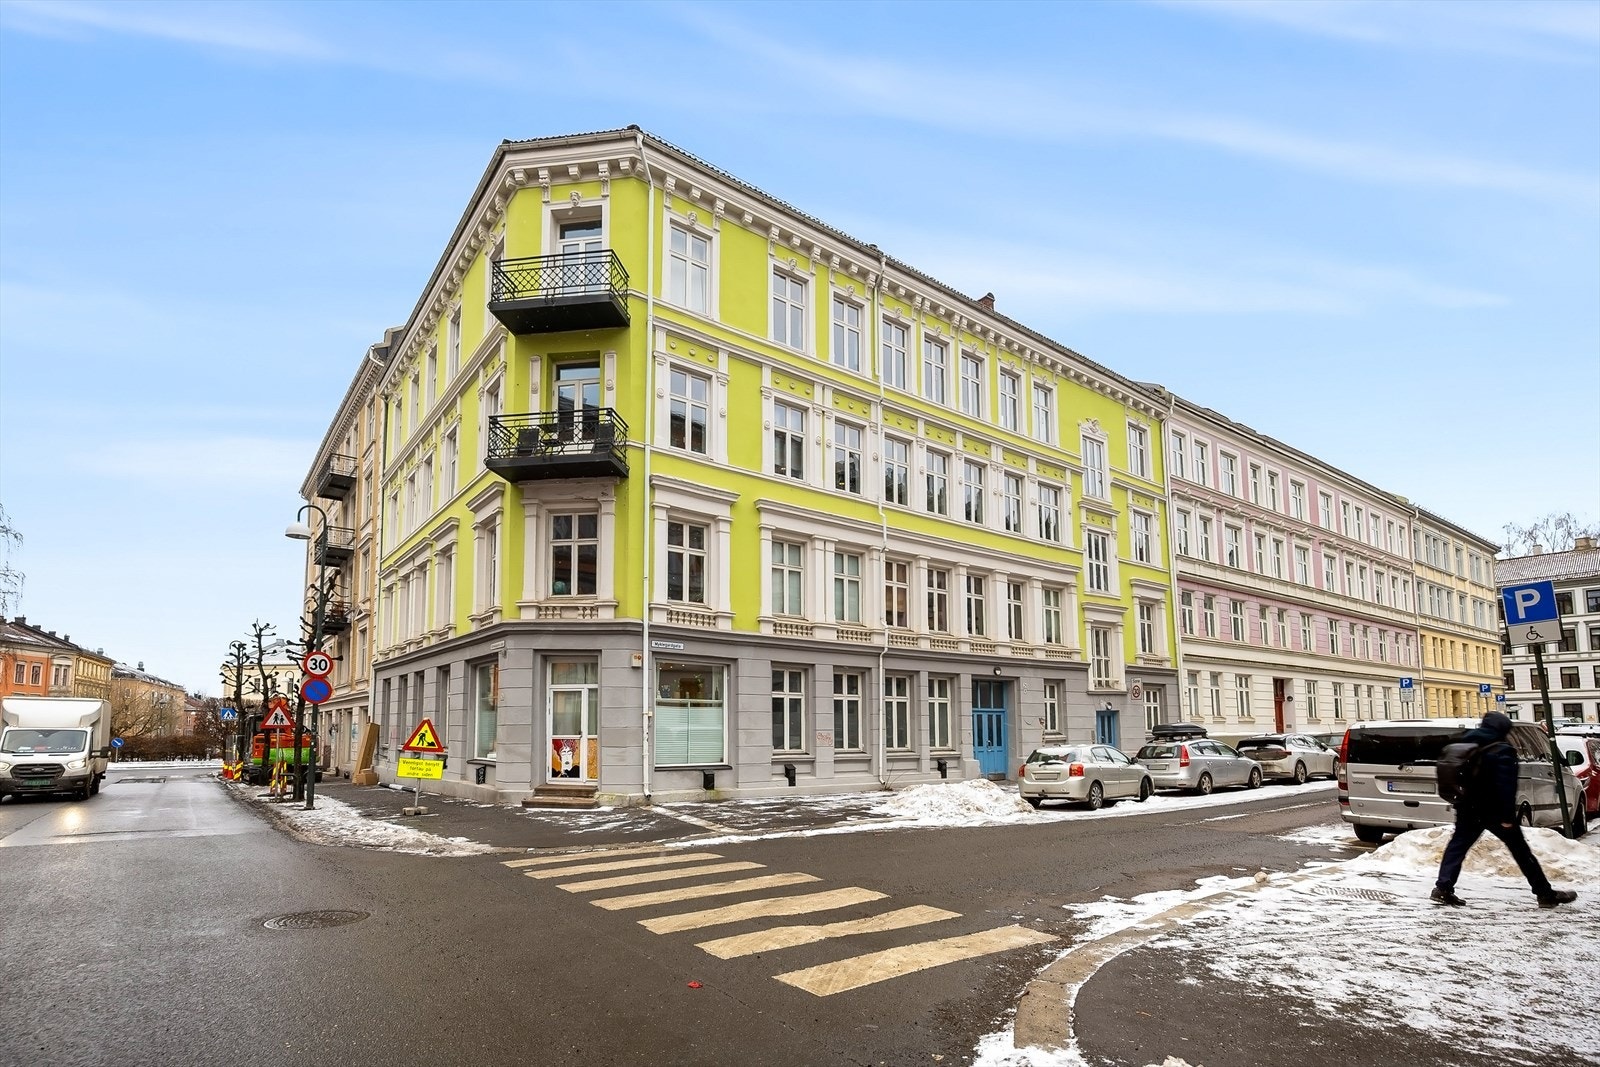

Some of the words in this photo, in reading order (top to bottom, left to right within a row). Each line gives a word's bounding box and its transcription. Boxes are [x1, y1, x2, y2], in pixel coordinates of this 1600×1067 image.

[1514, 588, 1541, 619] P
[310, 657, 328, 671] 30
[1402, 678, 1410, 687] P
[1481, 684, 1489, 692] P
